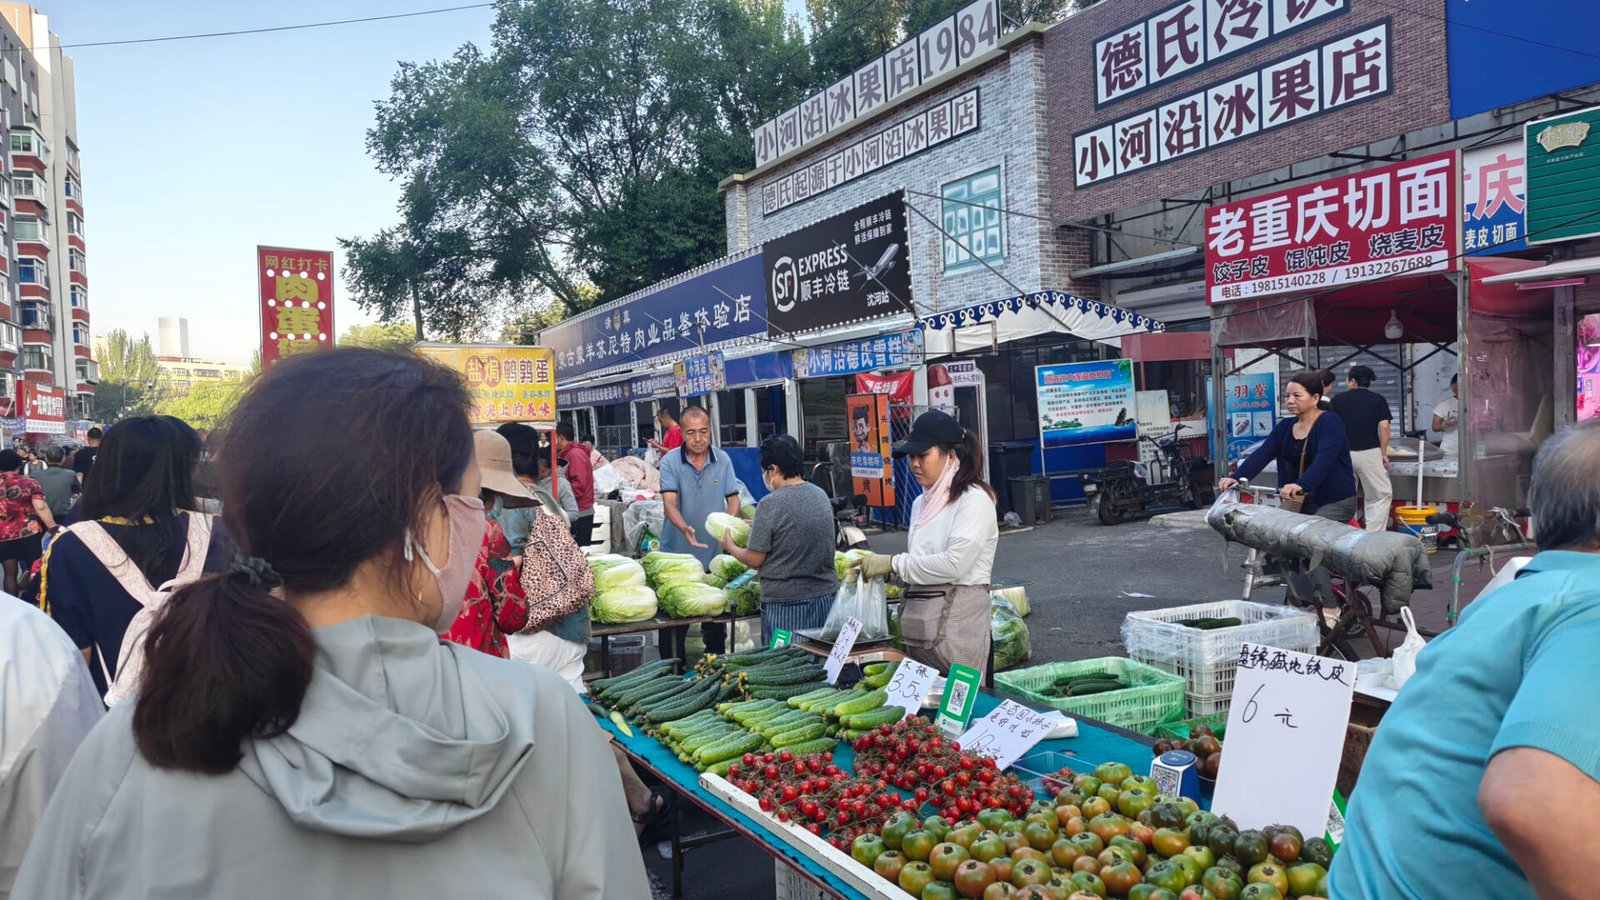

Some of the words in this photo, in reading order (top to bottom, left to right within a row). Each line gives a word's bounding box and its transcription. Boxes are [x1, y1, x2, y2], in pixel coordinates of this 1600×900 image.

[1078, 37, 1382, 181] 小河沿冰果店
[764, 95, 976, 211] 德氏起源于小河沿冰果店
[1464, 154, 1525, 221] 庆
[1208, 158, 1450, 257] 老重庆切面
[265, 255, 328, 272] 网红打卡
[798, 243, 848, 276] EXPRESS
[1213, 256, 1270, 284] 饺子皮
[1285, 241, 1351, 272] 馄饨皮
[1368, 224, 1445, 258] 烧麦皮
[1344, 255, 1433, 280] 19132267688
[800, 269, 850, 302] 顺丰冷链
[866, 290, 890, 307] 沈河站
[467, 358, 549, 384] 盐焗鹌鹑蛋
[810, 336, 903, 373] 小河沿德氏雪糕
[1225, 383, 1268, 398] 羽堂
